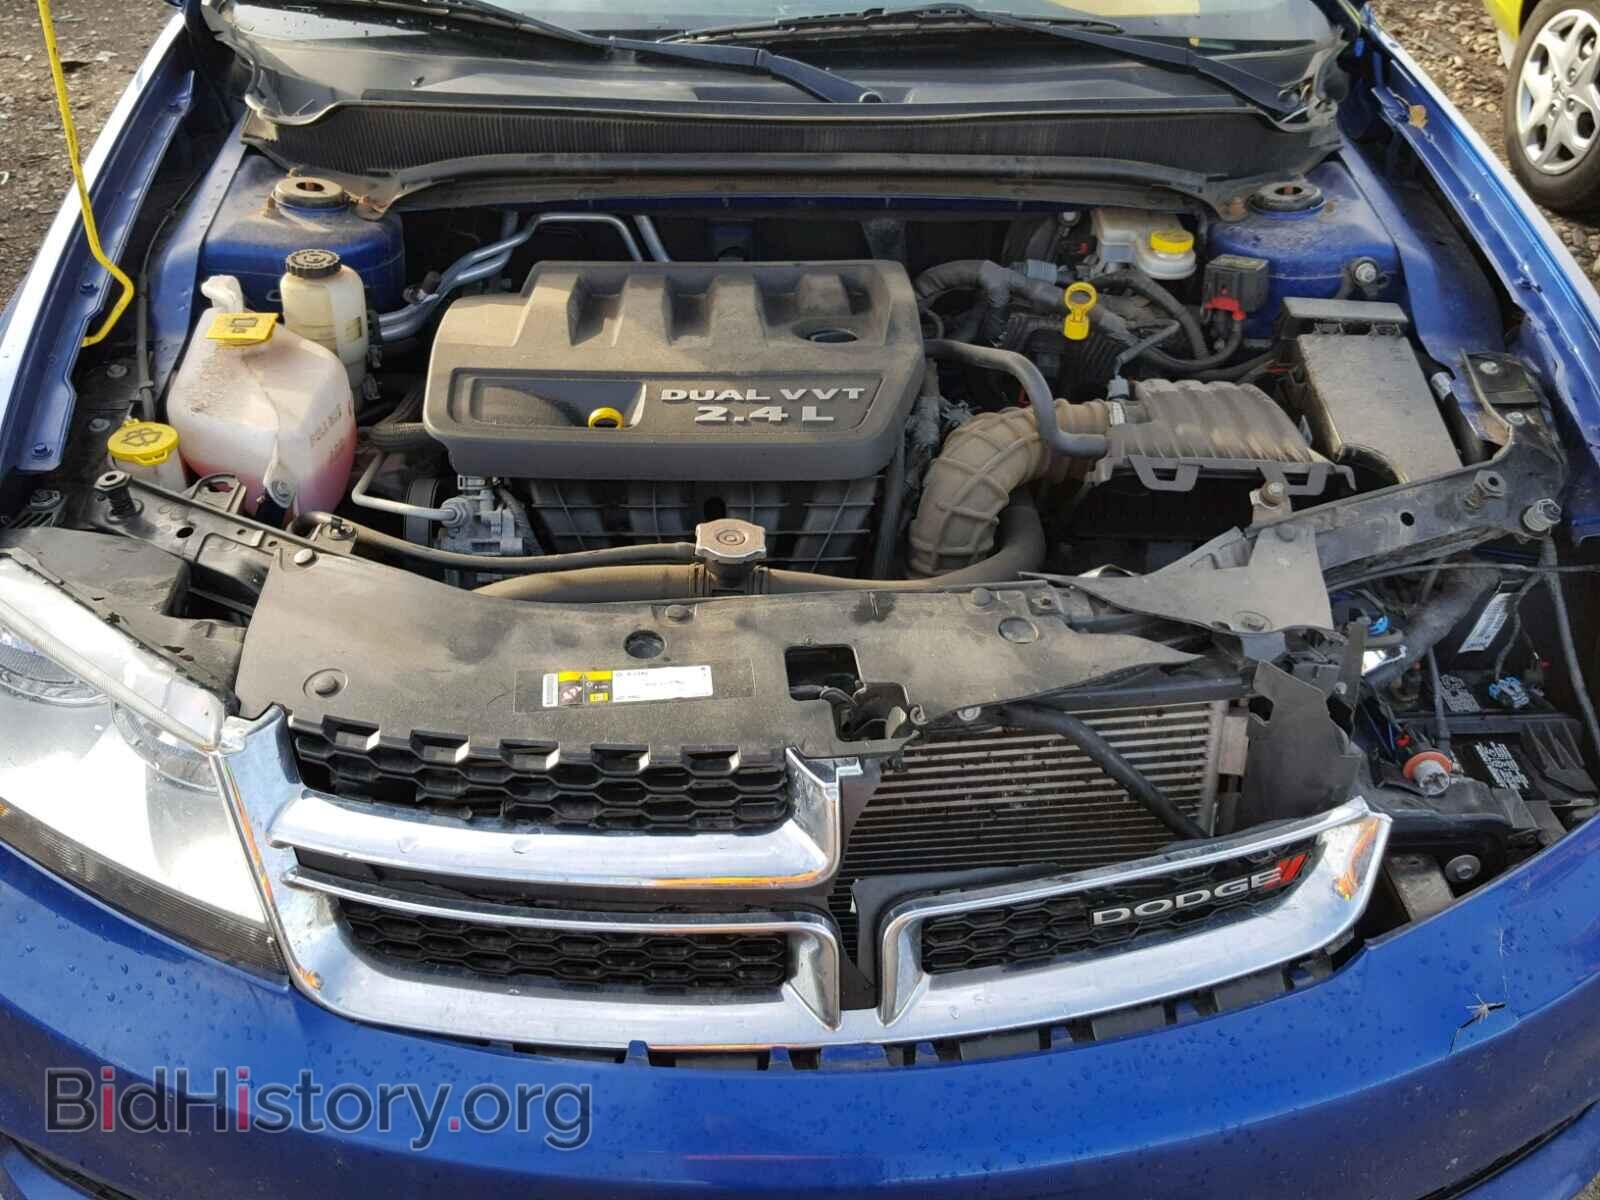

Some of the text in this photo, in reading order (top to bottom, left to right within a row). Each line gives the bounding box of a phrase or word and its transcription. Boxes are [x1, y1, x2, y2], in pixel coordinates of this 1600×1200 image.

[661, 387, 865, 401] DUAL VVT
[1093, 867, 1283, 926] DODGE
